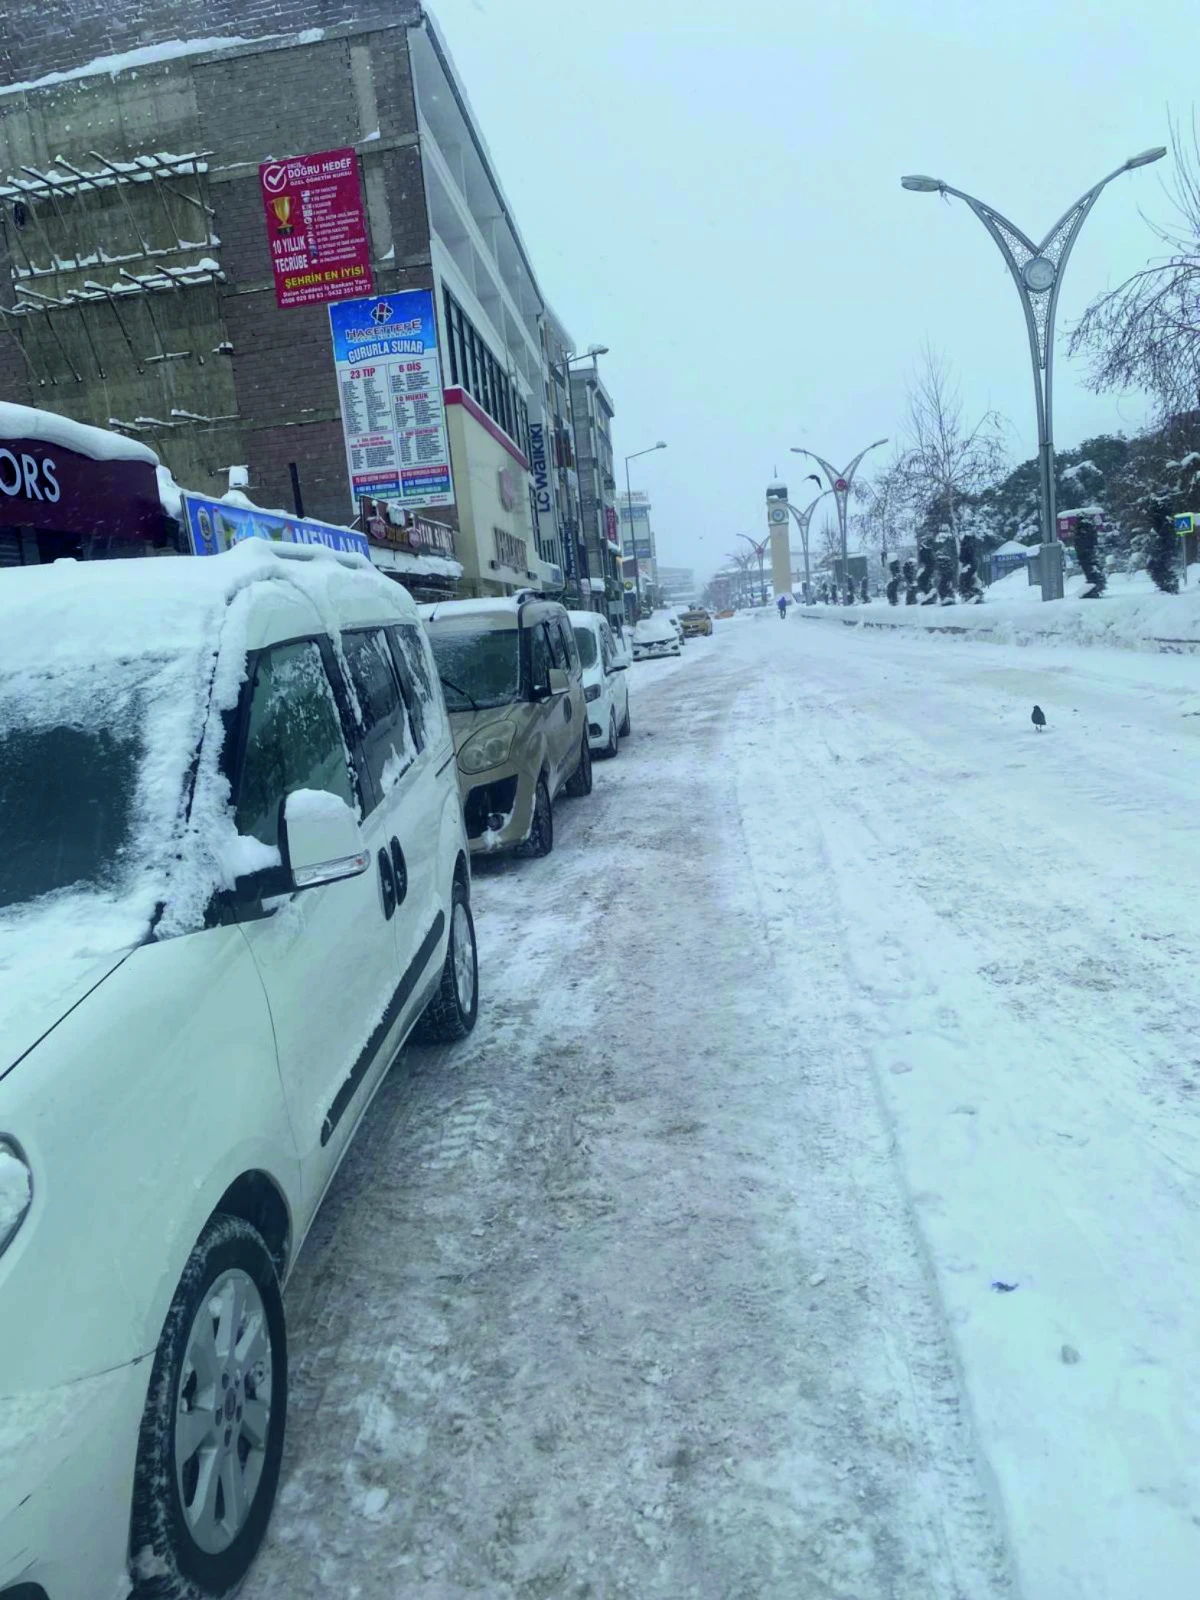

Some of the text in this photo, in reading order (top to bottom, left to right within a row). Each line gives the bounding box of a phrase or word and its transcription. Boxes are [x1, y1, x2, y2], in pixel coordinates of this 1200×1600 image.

[322, 158, 351, 172] HEDEF
[272, 239, 282, 254] 10
[281, 235, 306, 253] YILLIK
[275, 253, 309, 273] TECRÜBE
[285, 264, 364, 289] ŞEHRİN EN İYİSİ
[345, 318, 422, 339] HACETTEPE
[348, 340, 423, 363] GURURLA SUNAR
[350, 368, 376, 380] 23 TIP
[0, 448, 61, 503] ORS
